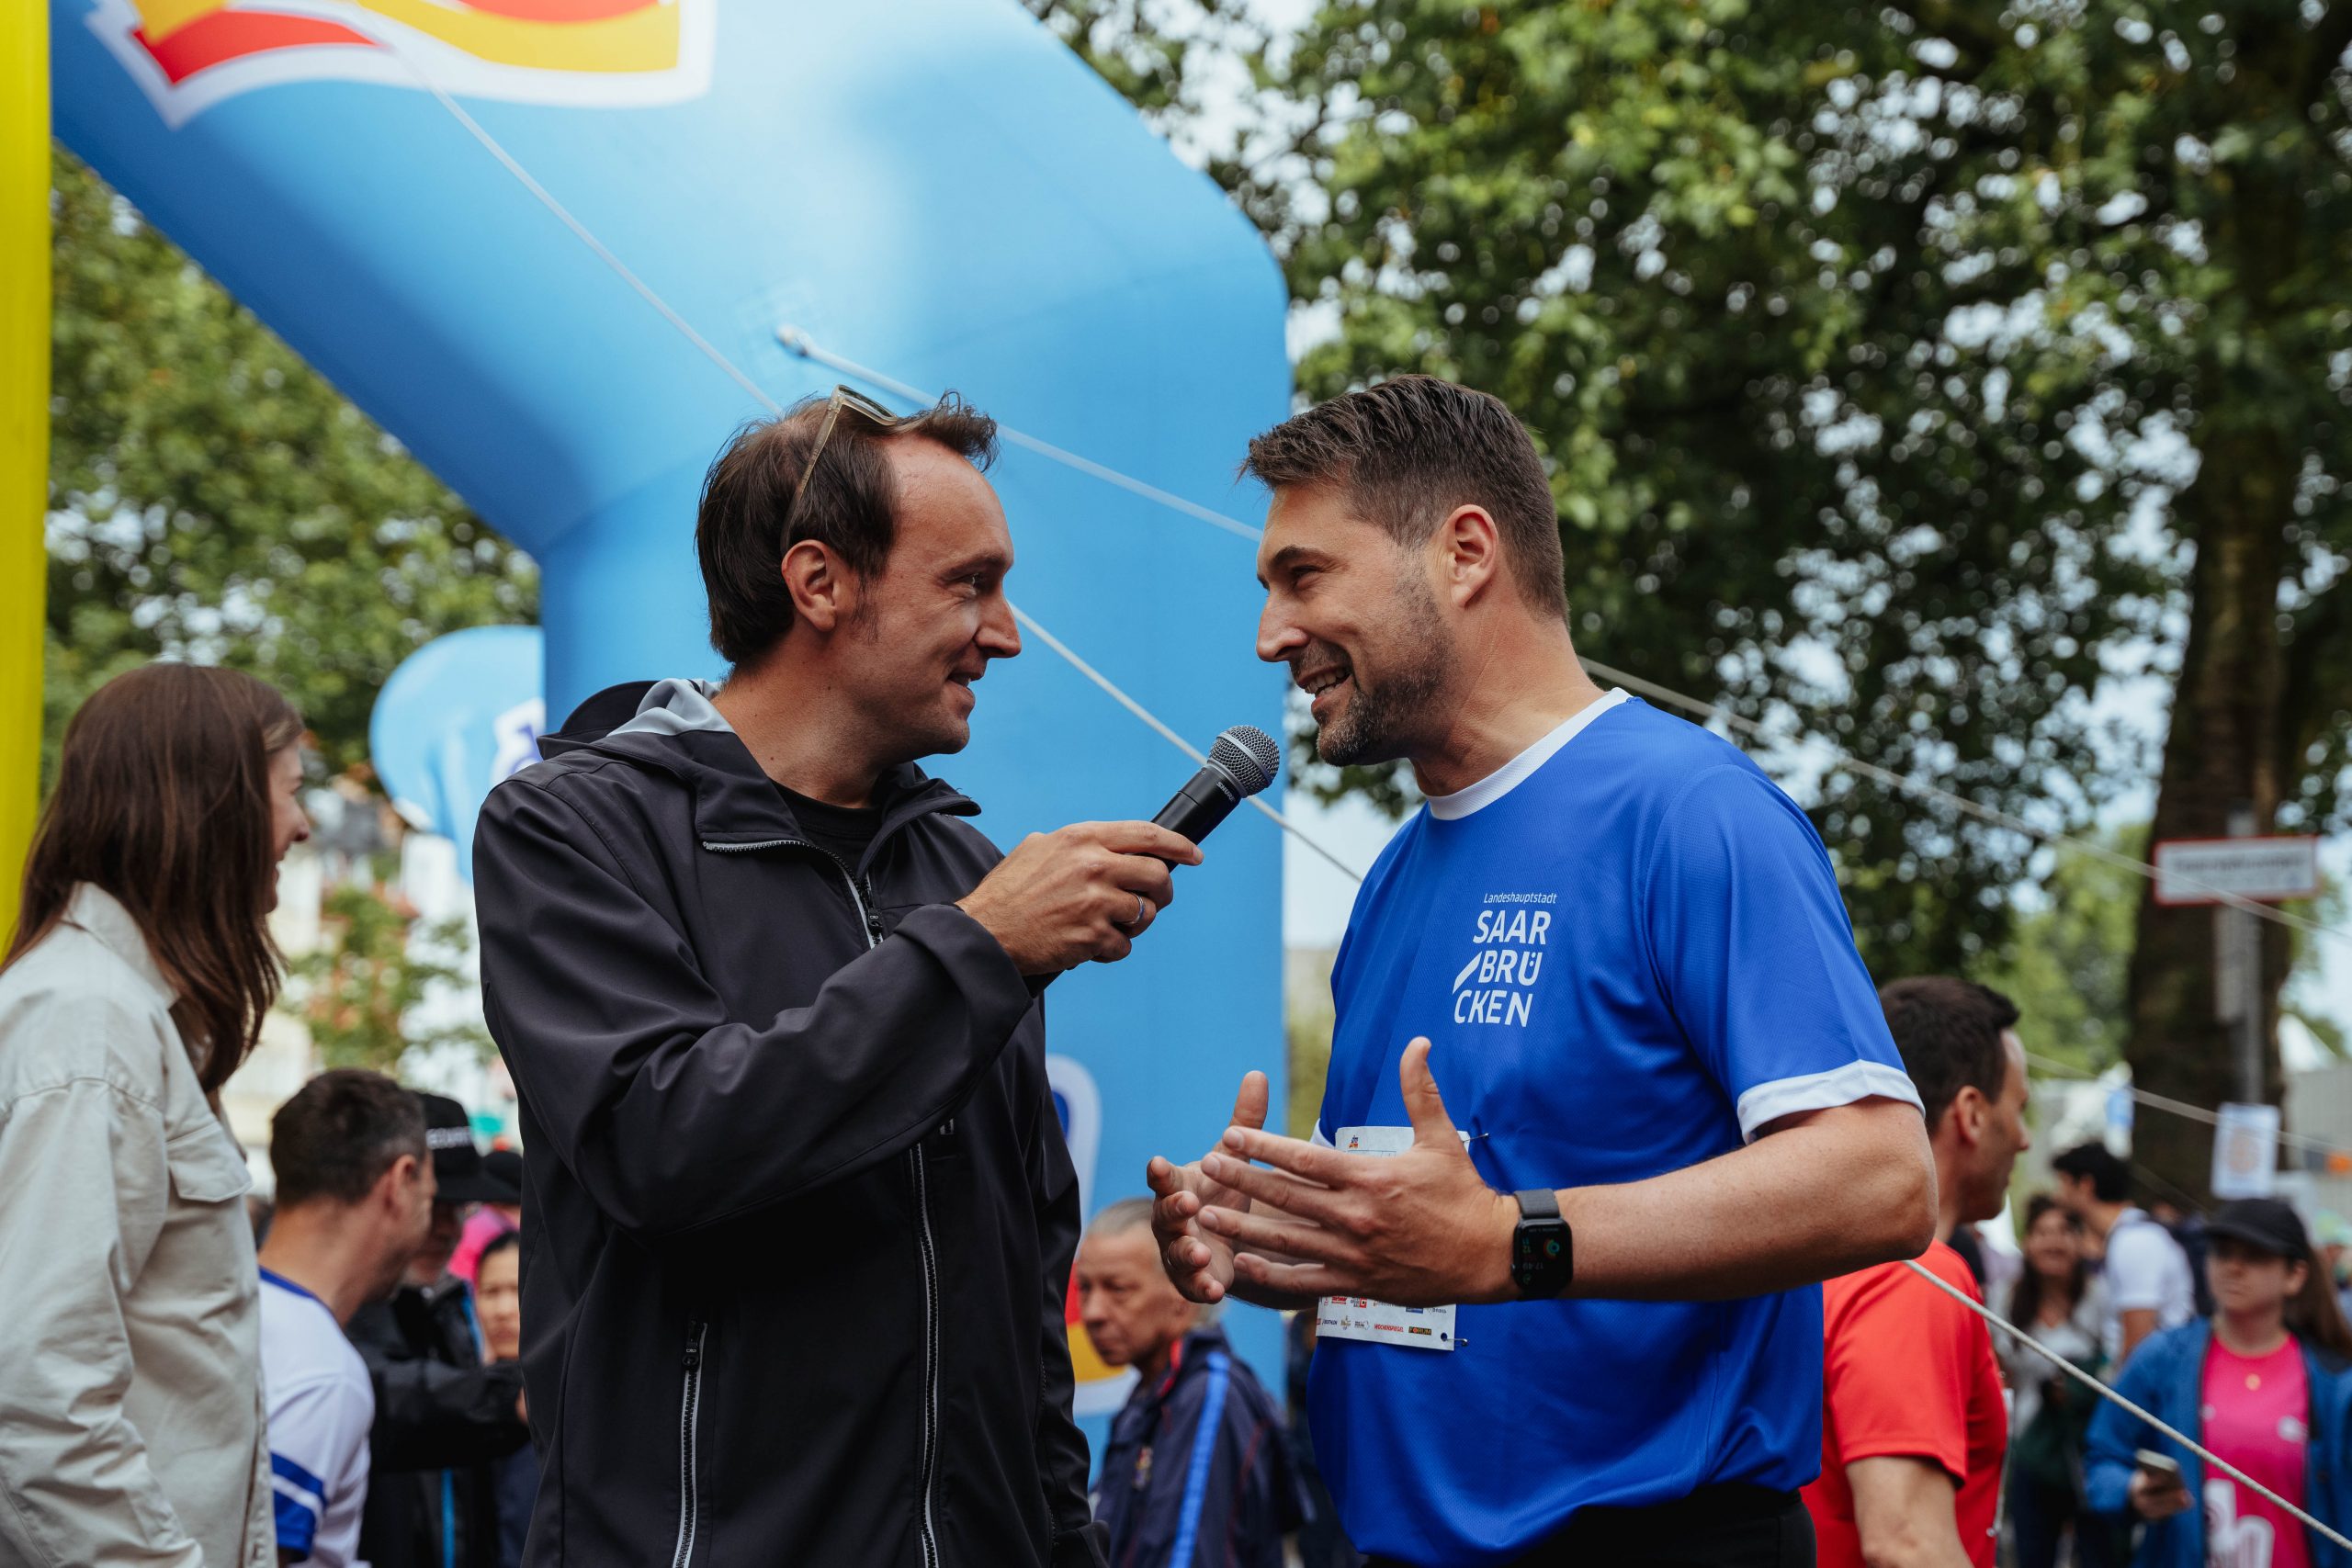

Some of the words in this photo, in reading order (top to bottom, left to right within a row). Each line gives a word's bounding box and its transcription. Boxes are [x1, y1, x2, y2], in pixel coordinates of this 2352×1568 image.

[1216, 781, 1236, 802] SHURE
[1483, 892, 1557, 905] Landeshauptstadt
[1472, 909, 1552, 945] SAAR
[1453, 989, 1533, 1028] CKEN
[1408, 1326, 1431, 1336] FORUM
